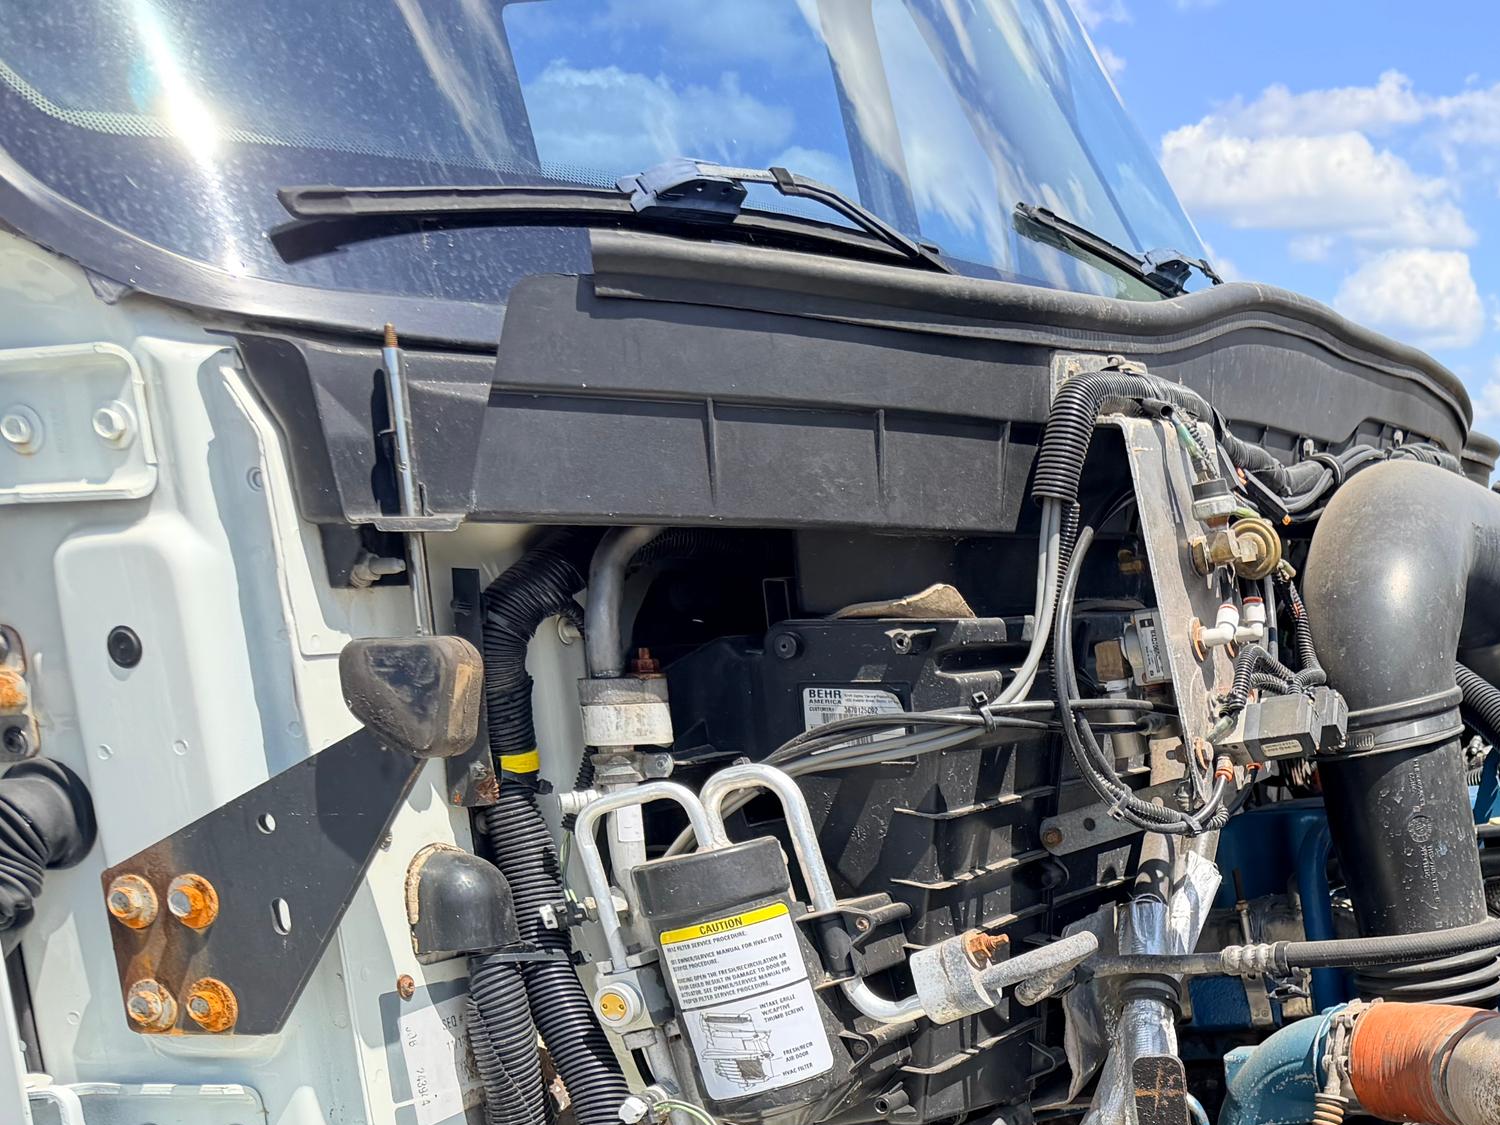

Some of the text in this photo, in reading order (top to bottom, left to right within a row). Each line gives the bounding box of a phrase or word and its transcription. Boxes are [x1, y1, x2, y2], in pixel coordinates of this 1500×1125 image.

[809, 689, 842, 698] BEHR
[699, 916, 742, 935] CAUTION
[691, 939, 711, 948] SERVICE
[716, 945, 740, 955] MANUAL
[752, 937, 767, 945] HVAC
[767, 933, 782, 941] FILTER
[732, 968, 756, 979] DAMAGE
[758, 969, 781, 979] MANUAL
[714, 988, 735, 998] SERVICE
[759, 994, 795, 1008] INTAKE GRILLE
[761, 1003, 790, 1015] W/CAPTIVE
[764, 1012, 784, 1022] THUMB
[782, 1062, 813, 1075] HVAC FILTER
